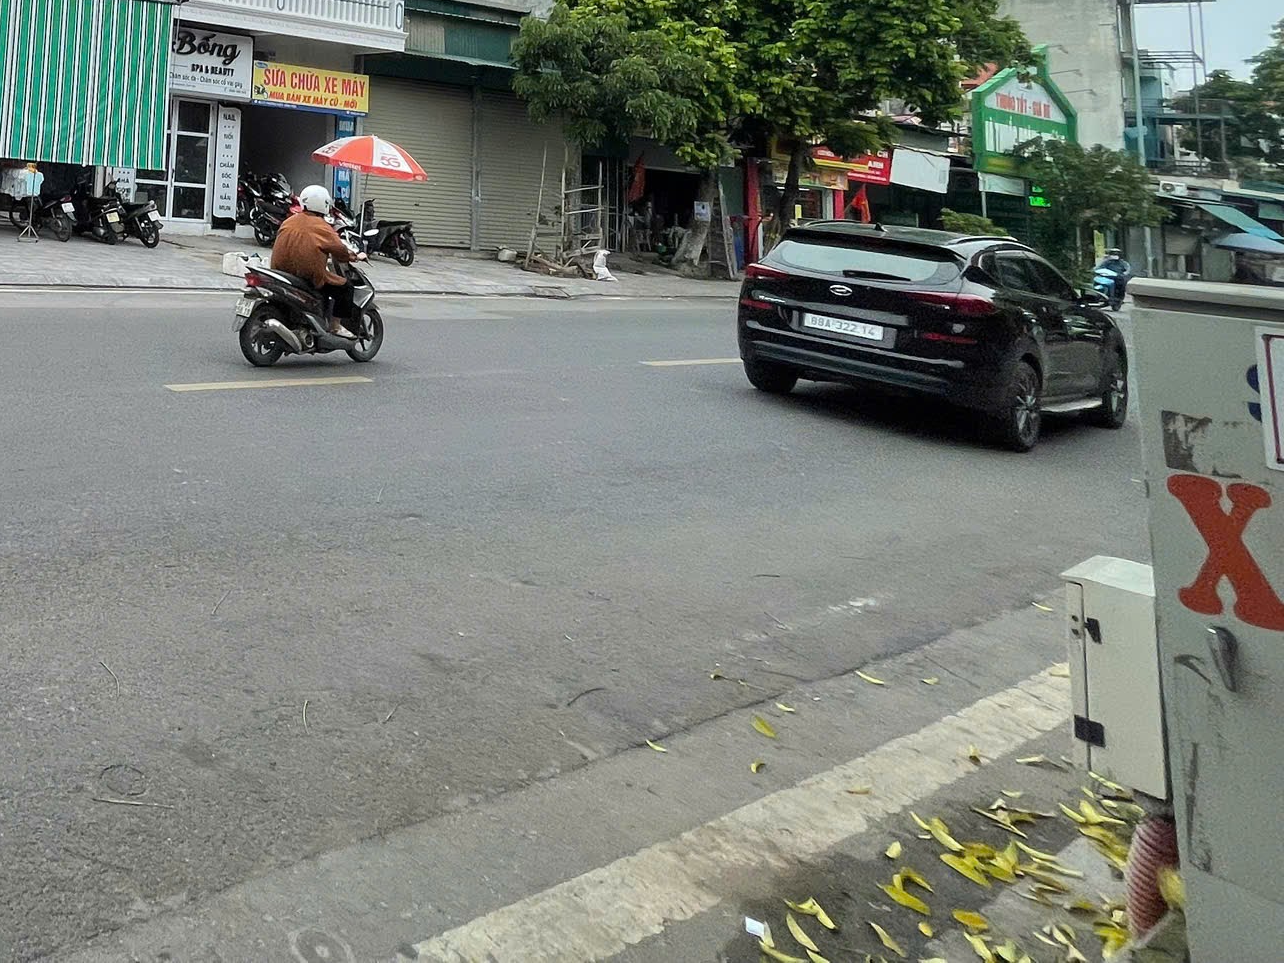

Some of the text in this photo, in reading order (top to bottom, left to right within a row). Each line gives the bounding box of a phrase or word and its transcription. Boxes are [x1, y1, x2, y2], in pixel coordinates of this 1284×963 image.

[263, 67, 365, 97] SỬA CHỮA XE MÁY
[302, 95, 311, 103] XE
[380, 156, 401, 168] 5G
